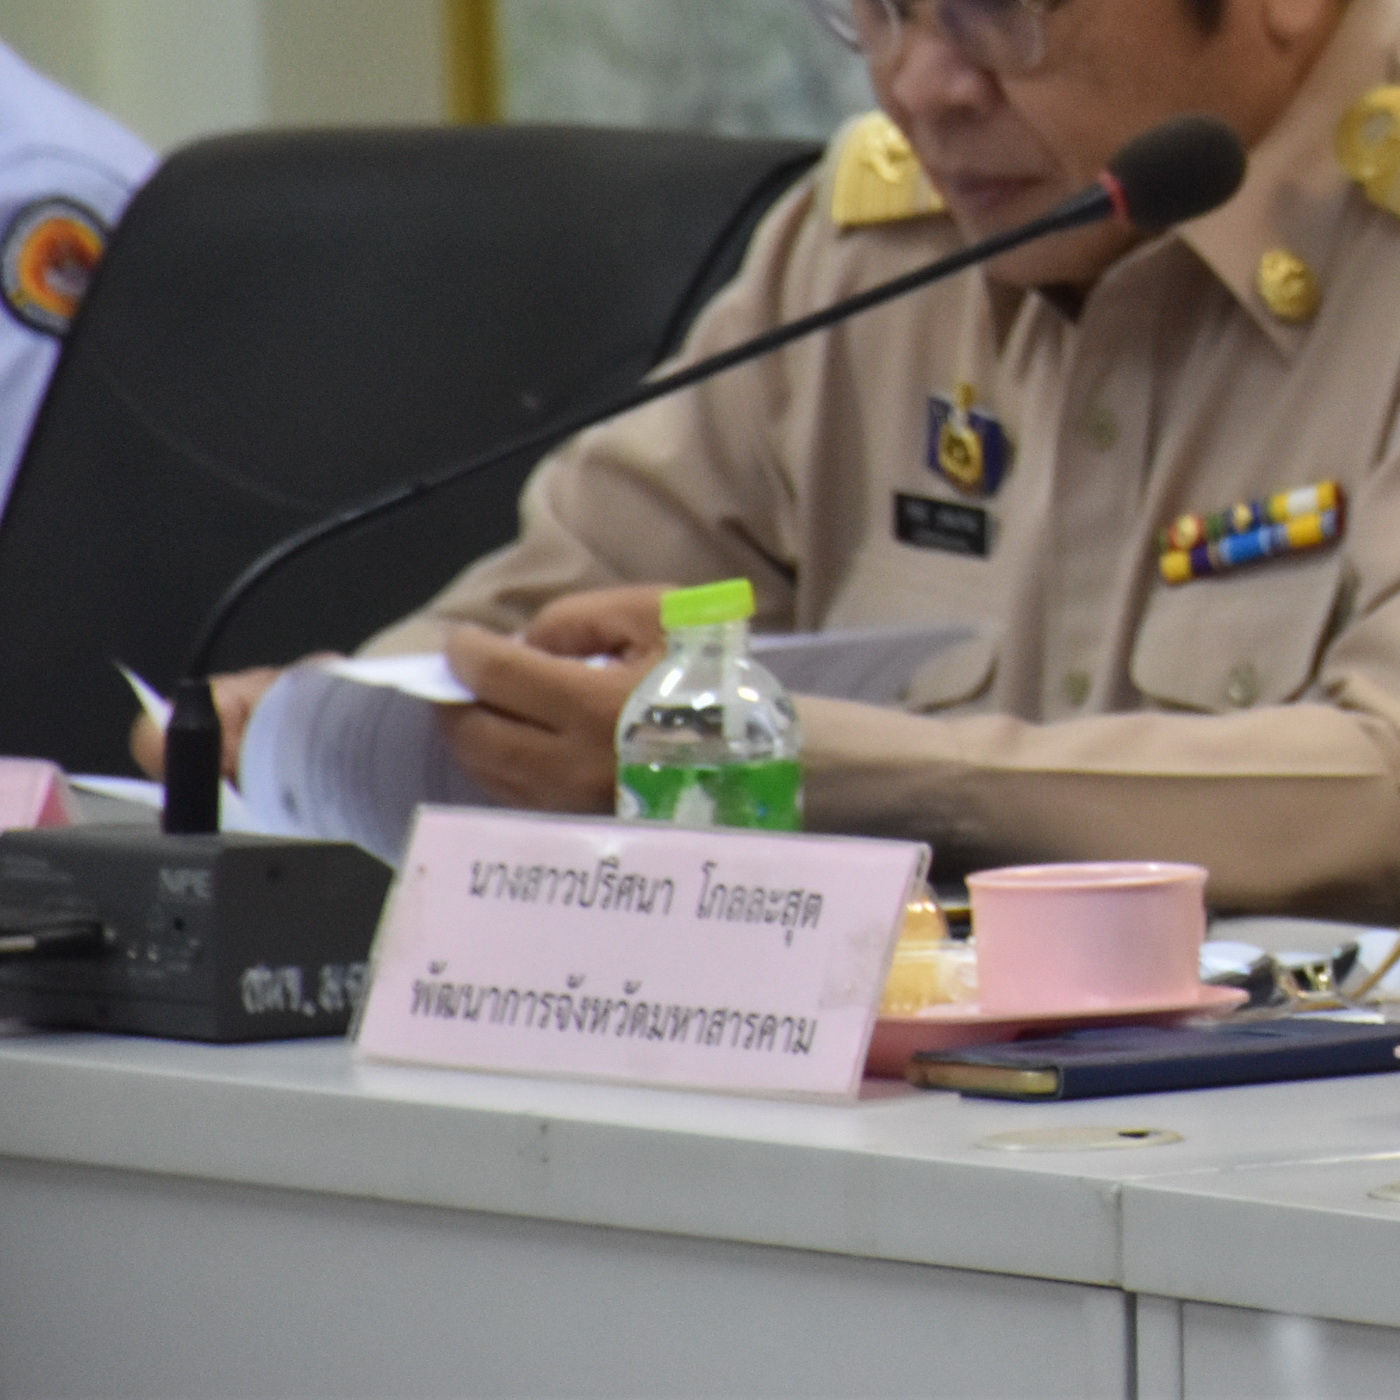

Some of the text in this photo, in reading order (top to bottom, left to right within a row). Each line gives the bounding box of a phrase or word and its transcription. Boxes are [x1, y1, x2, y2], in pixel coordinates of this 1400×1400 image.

[410, 959, 818, 1055] พัฒนาการจังหวัดมหาสารคาม
